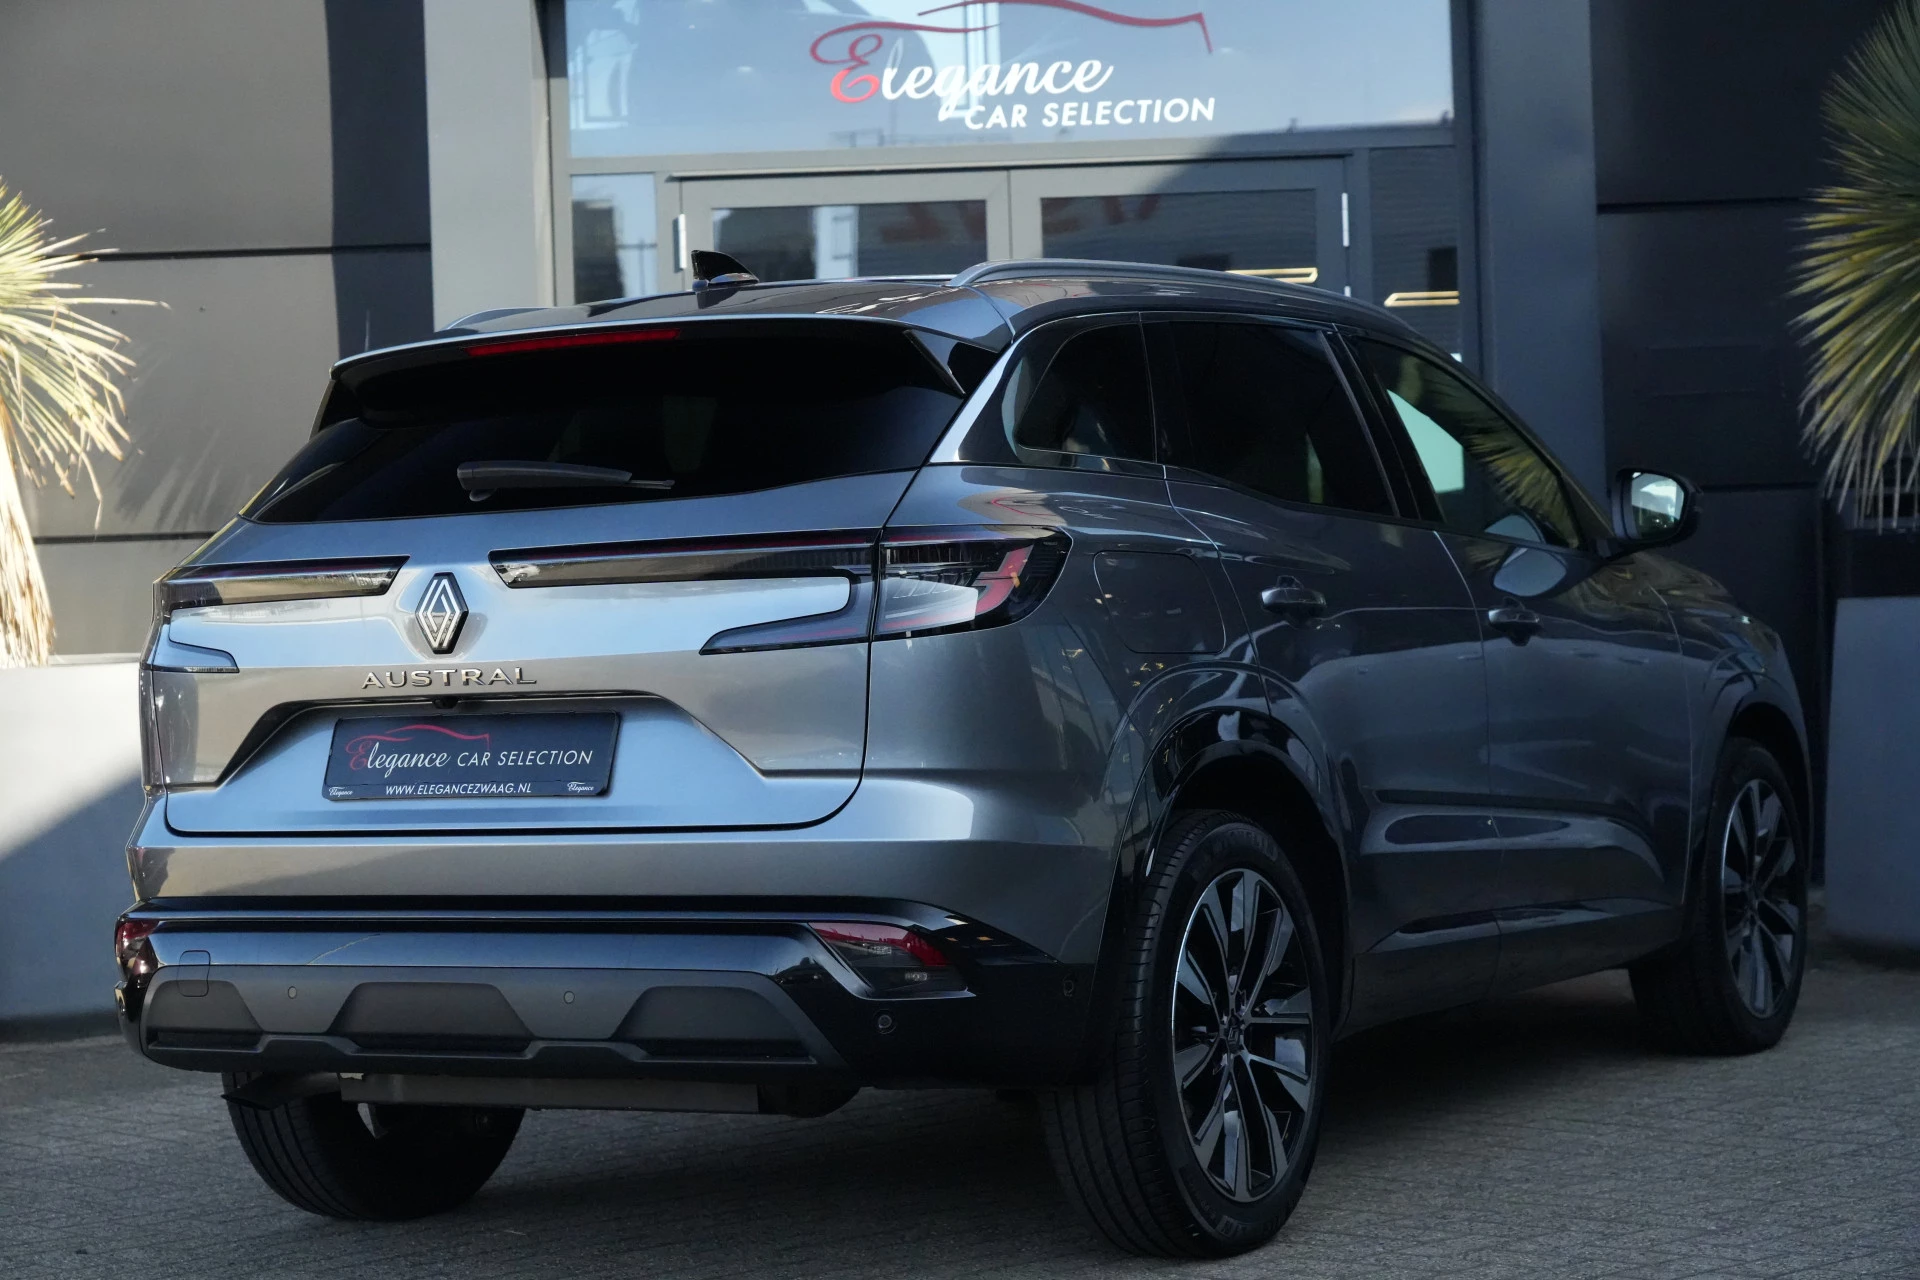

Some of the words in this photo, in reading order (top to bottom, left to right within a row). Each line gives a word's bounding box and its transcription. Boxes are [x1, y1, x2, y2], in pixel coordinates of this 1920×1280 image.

[810, 21, 1114, 122] Elegance
[964, 104, 1027, 130] CAR
[1041, 97, 1216, 127] SELECTION
[361, 666, 537, 690] AUSTRAL
[346, 735, 451, 778] Elegance
[457, 752, 491, 767] CAR
[498, 750, 593, 766] SELECTION
[385, 782, 532, 796] WWW.ELEGANCEZWAAG.NL
